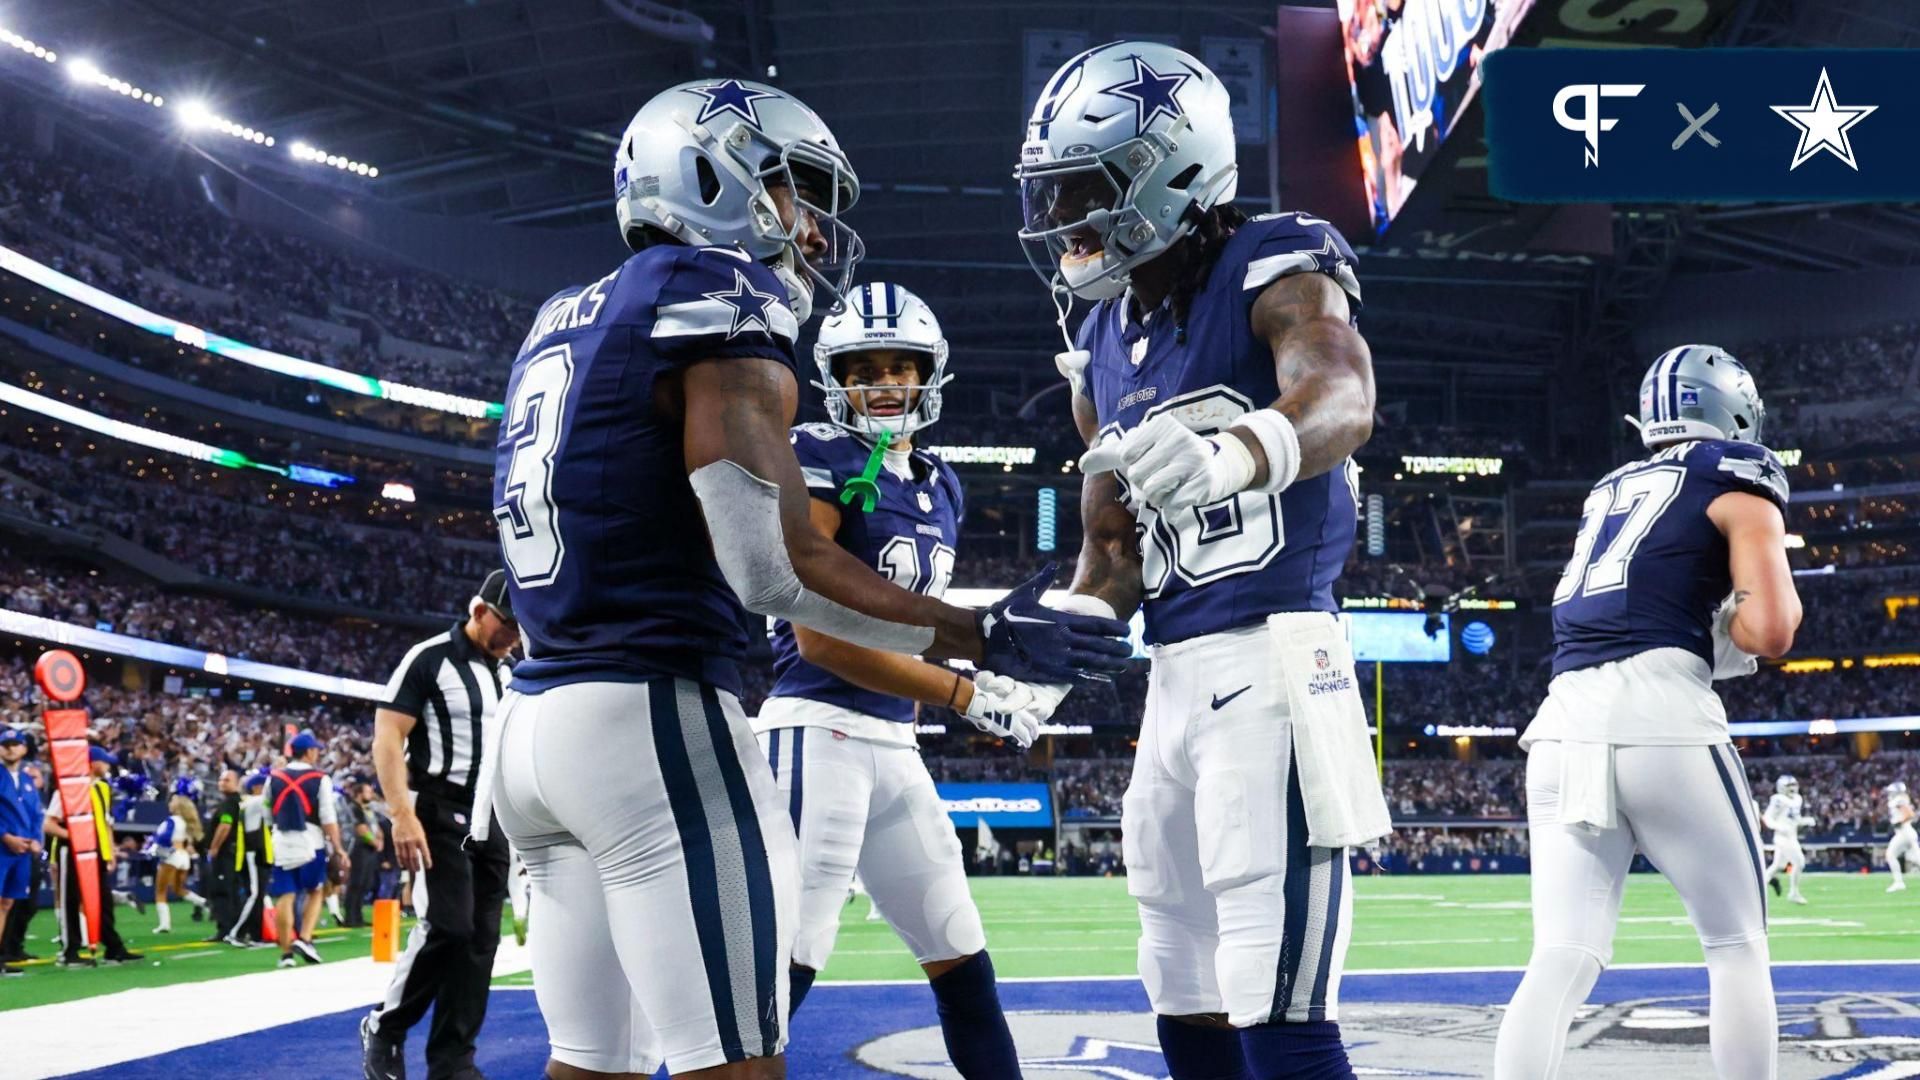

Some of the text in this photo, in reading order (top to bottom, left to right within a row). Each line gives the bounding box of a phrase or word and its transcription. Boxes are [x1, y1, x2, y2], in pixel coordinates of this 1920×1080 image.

[1648, 425, 1687, 438] COWBOYS
[492, 342, 575, 590] 3
[1401, 455, 1503, 475] TOUCHDOWN
[1308, 677, 1351, 696] CHANGE
